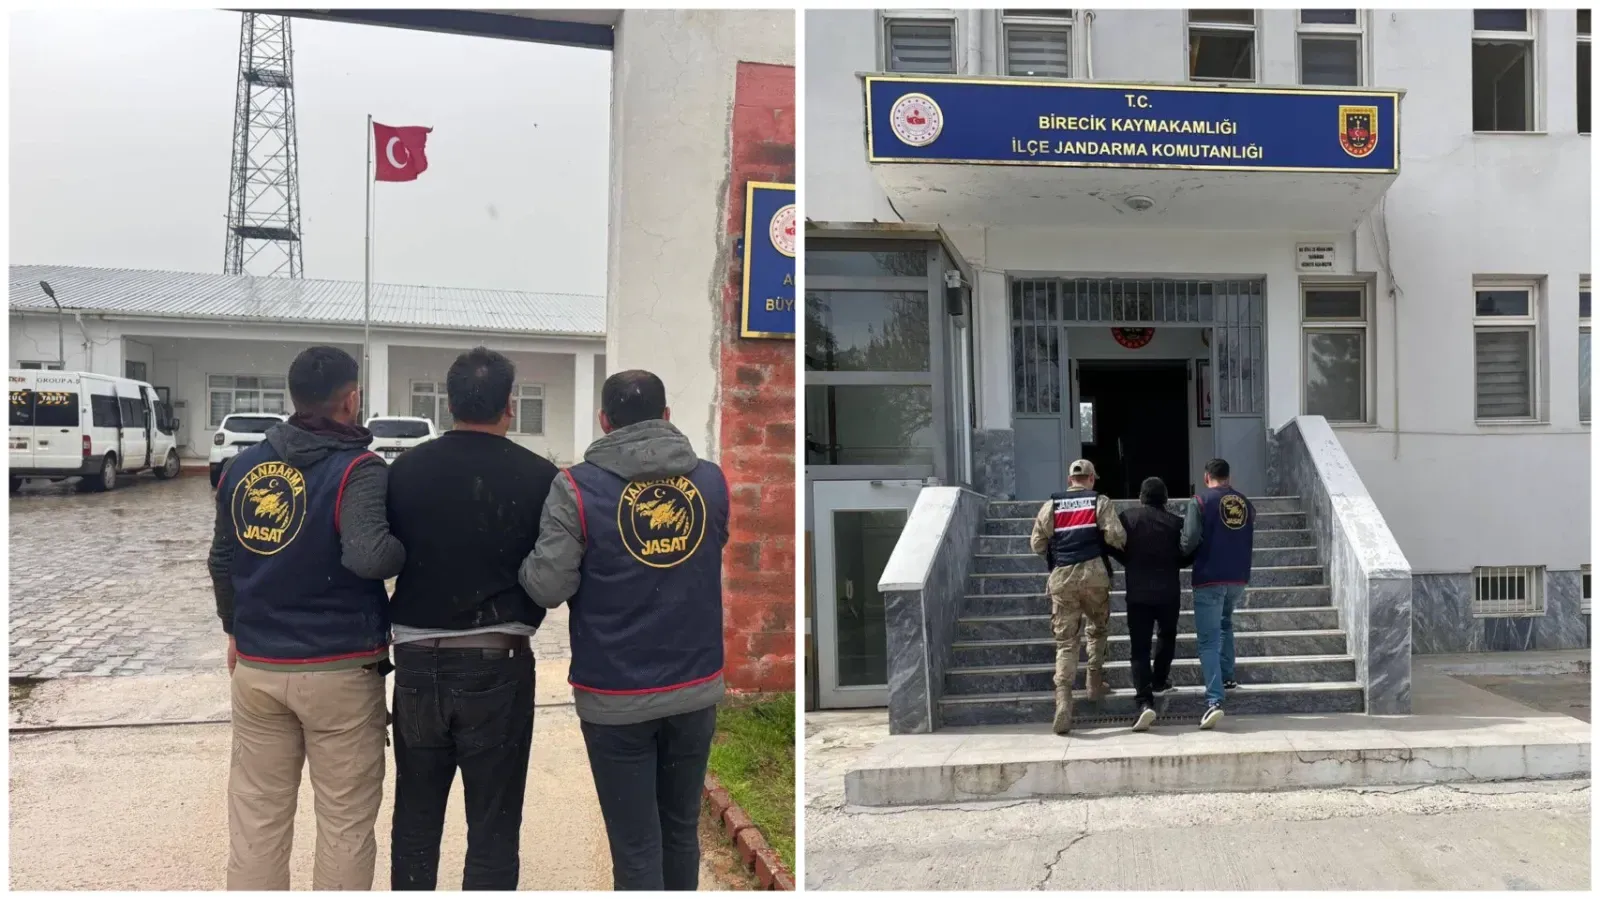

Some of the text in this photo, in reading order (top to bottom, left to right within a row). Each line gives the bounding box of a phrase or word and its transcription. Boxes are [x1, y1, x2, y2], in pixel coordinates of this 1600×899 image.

[1124, 94, 1153, 108] T.C.
[1038, 113, 1237, 134] BİRECİK KAYMAKAMLIĞI
[1011, 136, 1263, 159] İLÇE JANDARMA KOMUTANLIĞI
[783, 273, 796, 285] A
[765, 296, 796, 311] BÜY
[244, 464, 304, 497] JANDARMA
[243, 524, 285, 543] JASAT
[641, 535, 688, 556] JASAT
